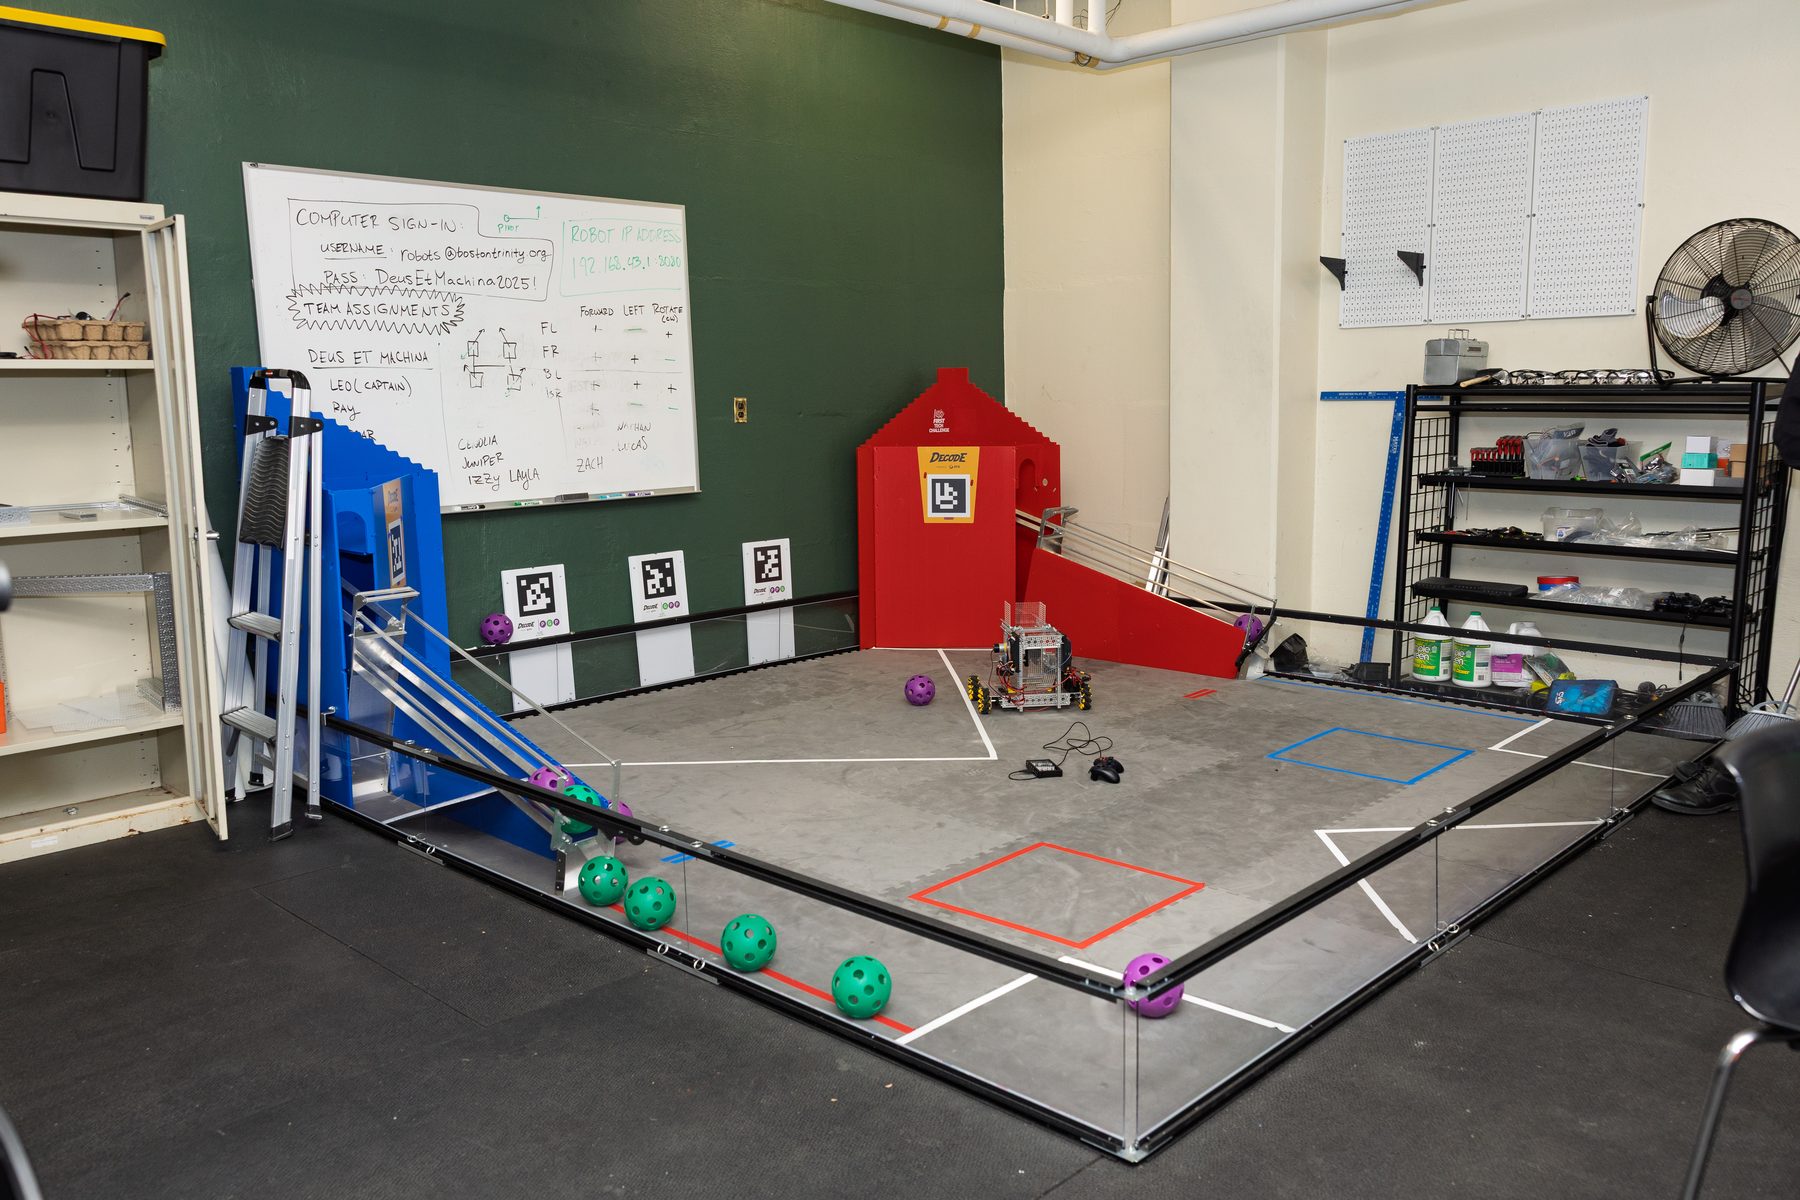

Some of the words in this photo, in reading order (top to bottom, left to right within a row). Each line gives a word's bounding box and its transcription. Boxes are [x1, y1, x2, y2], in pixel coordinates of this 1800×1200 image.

[296, 208, 380, 228] COMPUTER
[571, 225, 615, 244] ROBOT
[621, 225, 633, 242] IP
[303, 302, 342, 315] TEAM
[346, 302, 451, 318] ASSIGNMENTS
[580, 305, 615, 318] FORWARD
[623, 304, 645, 317] LEFT
[651, 302, 683, 315] ROTATE
[540, 321, 558, 335] FL
[307, 348, 345, 364] DEUS
[353, 350, 373, 365] ET
[379, 350, 429, 365] MACHINA
[542, 344, 560, 359] FR
[331, 400, 361, 421] RAY
[575, 455, 604, 473] ZACH
[930, 452, 967, 463] DECODE
